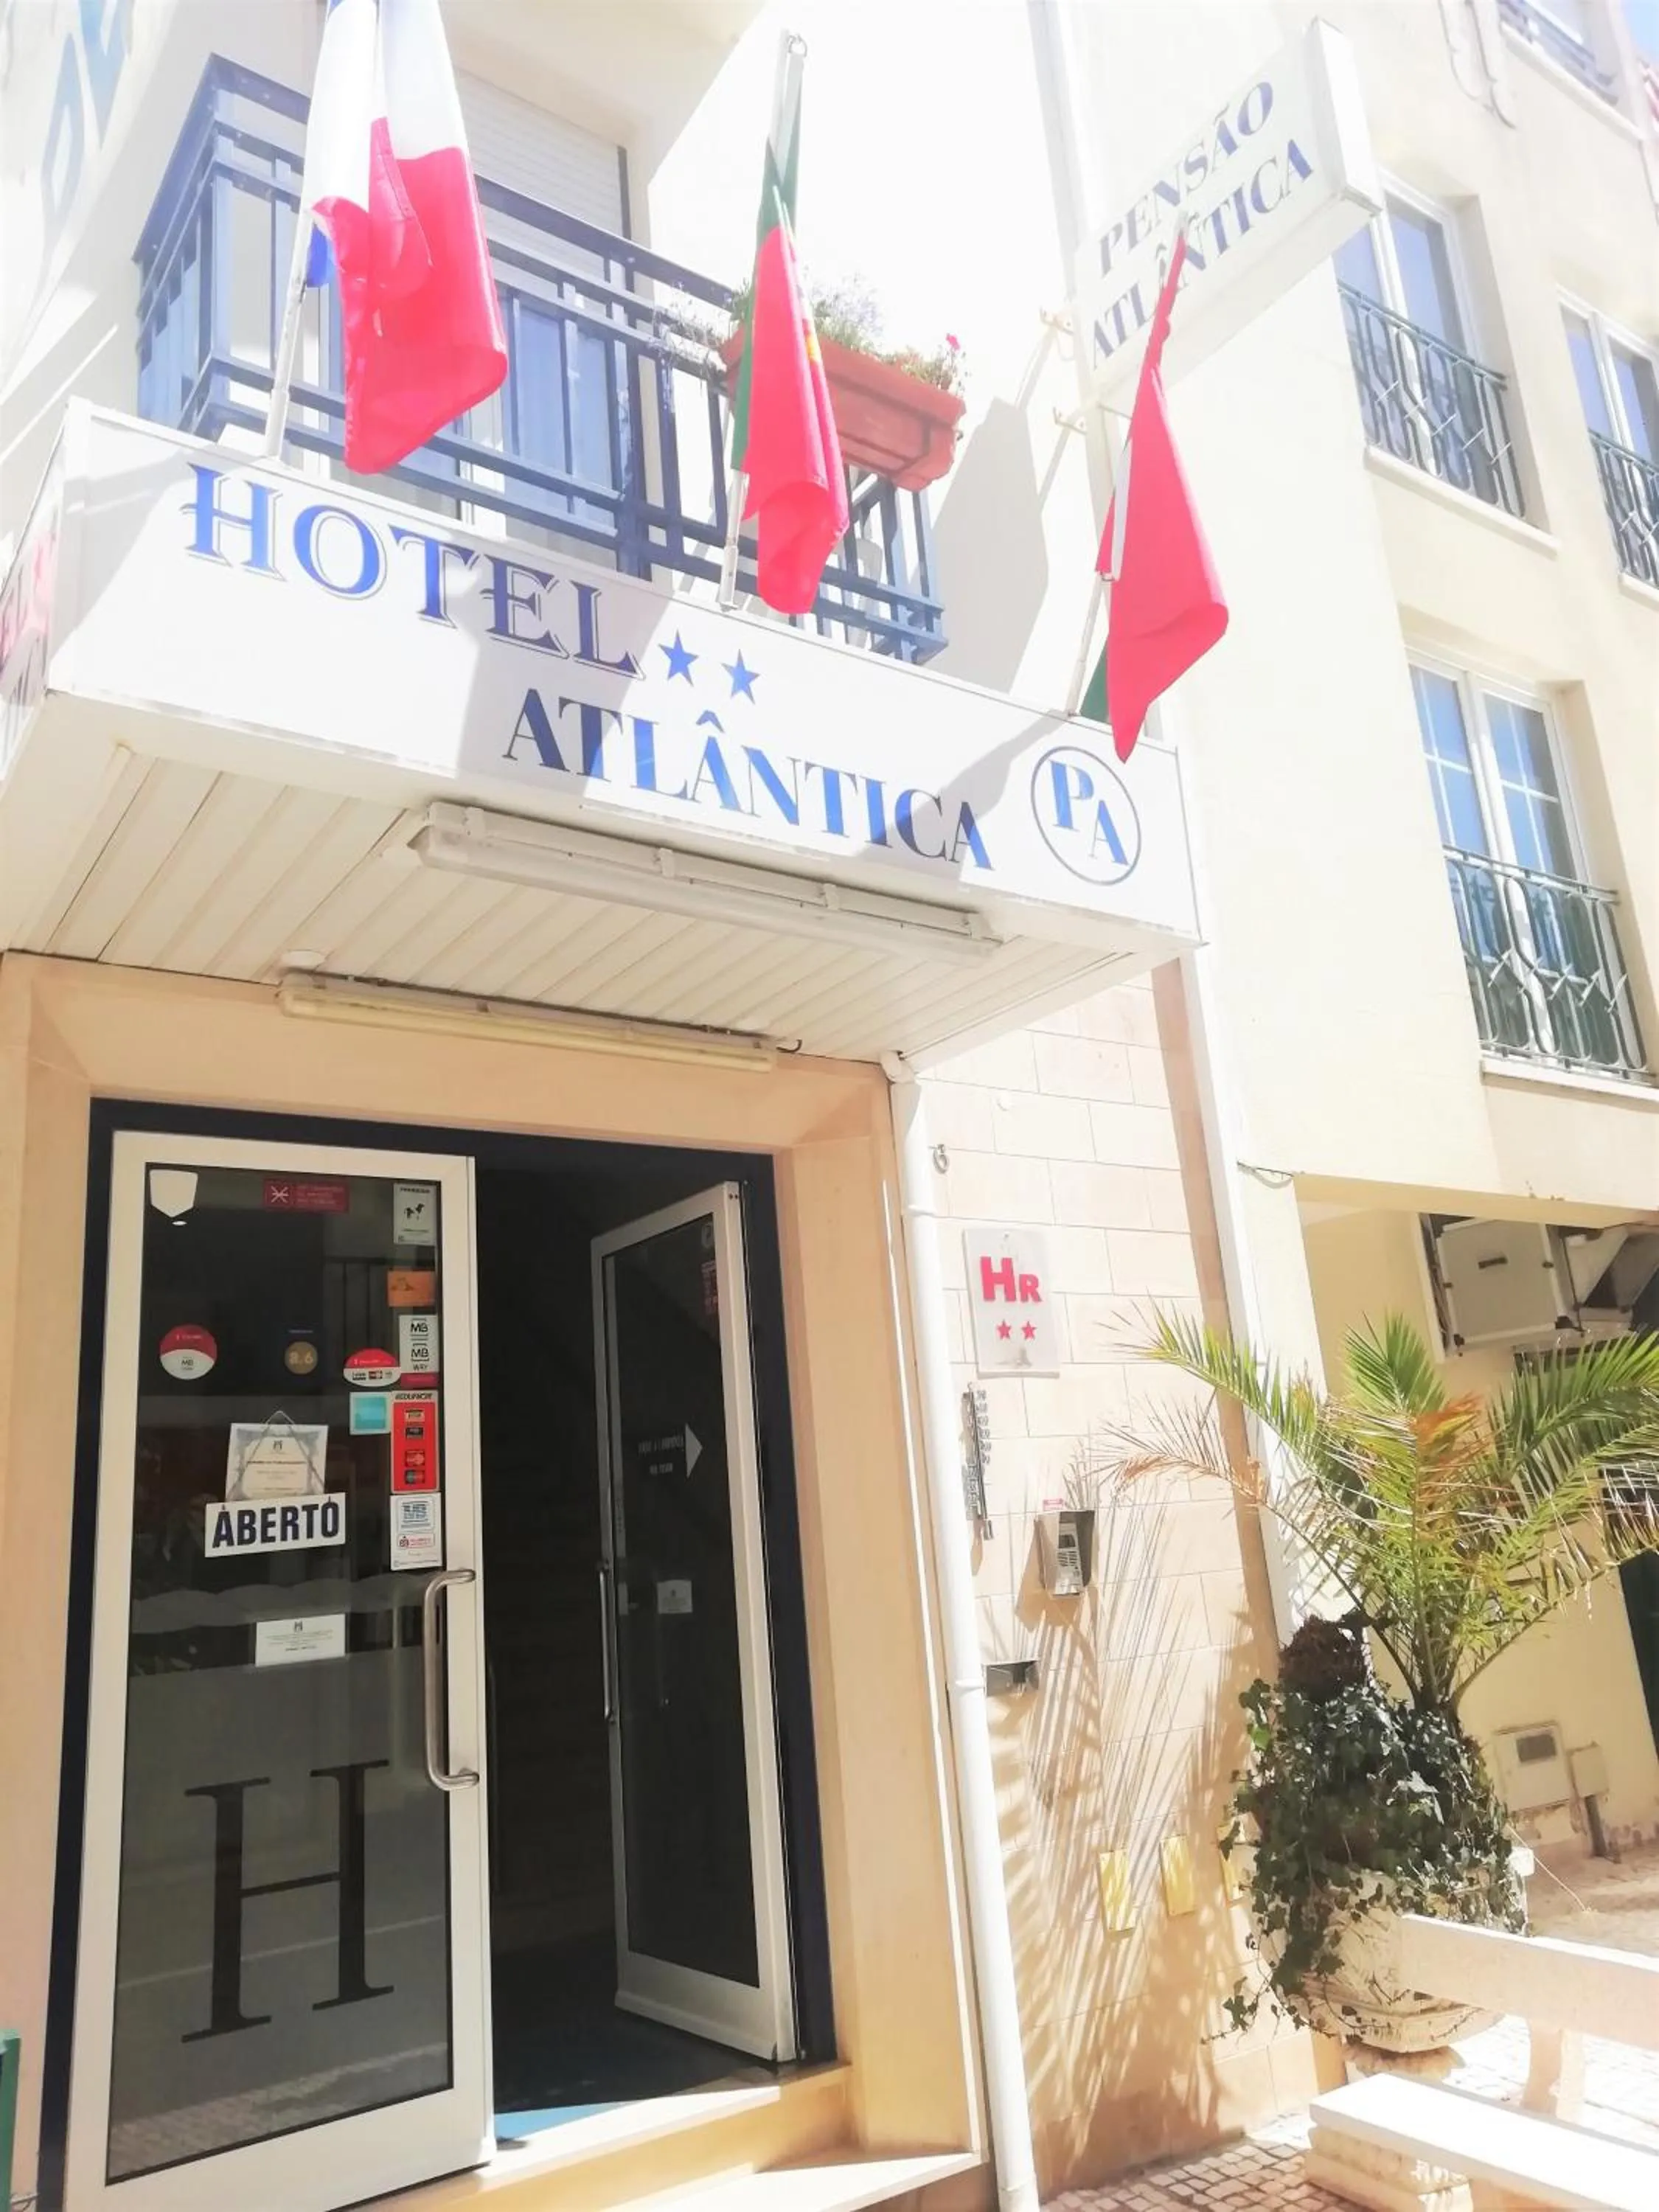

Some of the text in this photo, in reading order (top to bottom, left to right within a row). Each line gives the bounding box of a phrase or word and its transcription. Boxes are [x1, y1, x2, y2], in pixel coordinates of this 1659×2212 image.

[1099, 81, 1274, 279] PENSÃO
[179, 462, 647, 681] HOTEL
[502, 688, 995, 871] ATLÂNTICA
[212, 1501, 339, 1548] ABERTO
[181, 1759, 394, 2044] H
